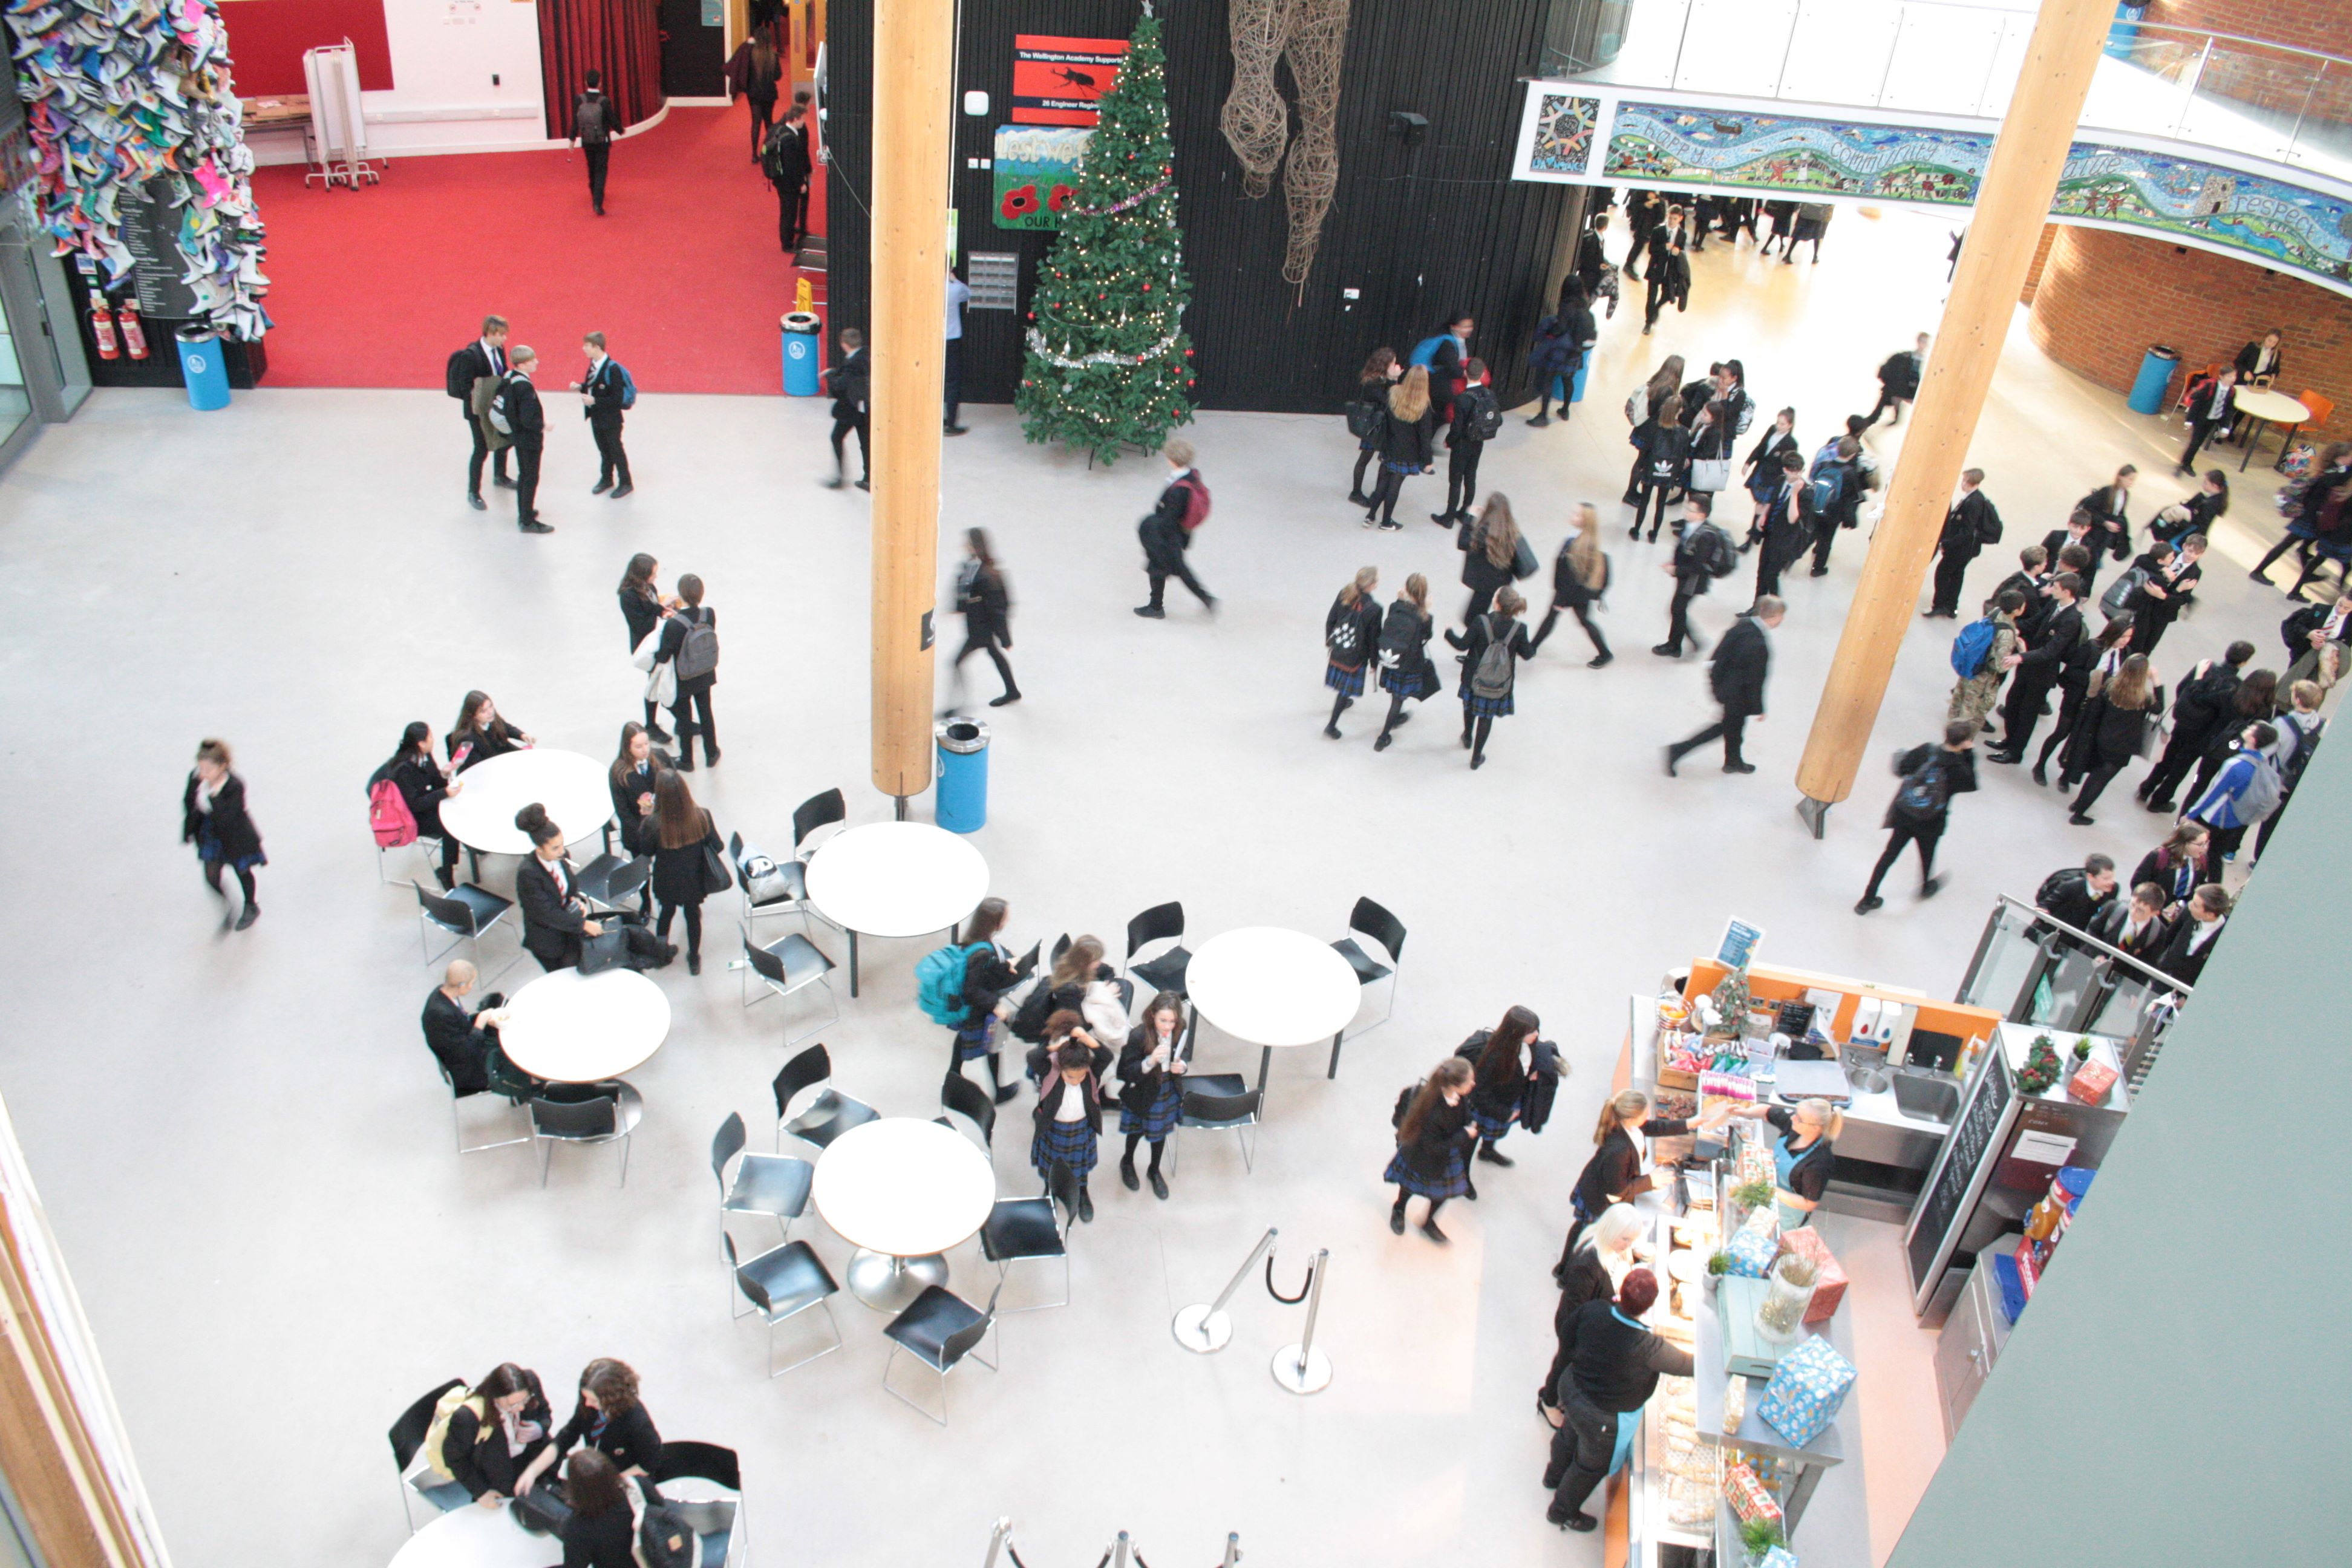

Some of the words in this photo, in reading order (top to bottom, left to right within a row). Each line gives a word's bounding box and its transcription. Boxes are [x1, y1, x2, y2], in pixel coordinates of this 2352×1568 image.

[1033, 52, 1065, 61] Wellington
[1065, 54, 1094, 64] Academy
[1051, 100, 1078, 109] Engineer
[1079, 102, 1099, 110] Regim
[995, 134, 1040, 163] Lest
[2062, 157, 2121, 179] alue
[1024, 216, 1050, 227] OUR
[2234, 195, 2314, 240] respect
